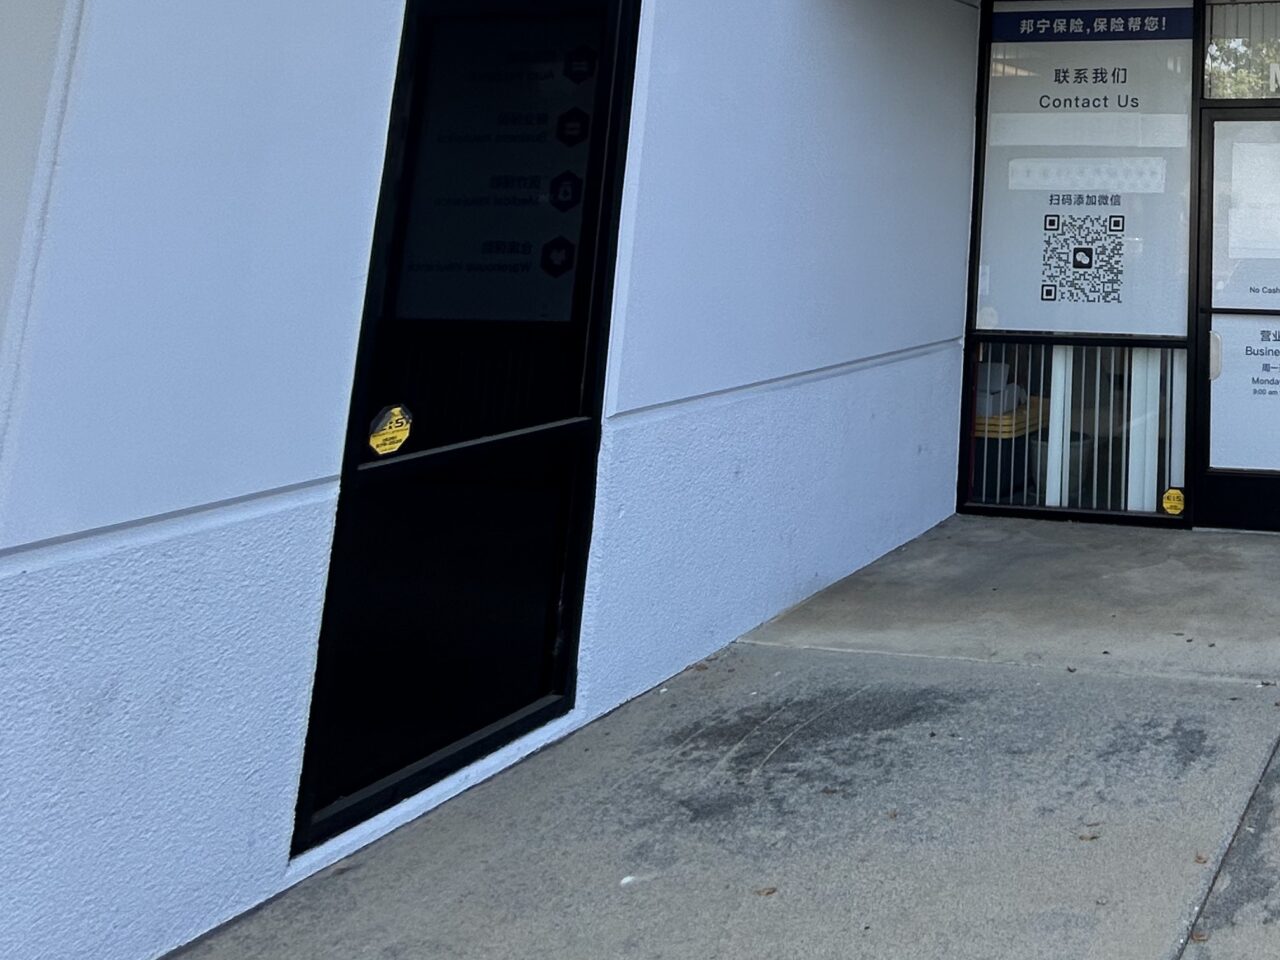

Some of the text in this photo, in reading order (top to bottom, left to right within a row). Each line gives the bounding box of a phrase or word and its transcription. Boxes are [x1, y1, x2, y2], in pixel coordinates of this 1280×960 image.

[1053, 68, 1128, 85] 联系我们
[1039, 94, 1140, 109] Contact Us
[1049, 193, 1121, 206] 扫码添加微信
[1249, 286, 1260, 294] No
